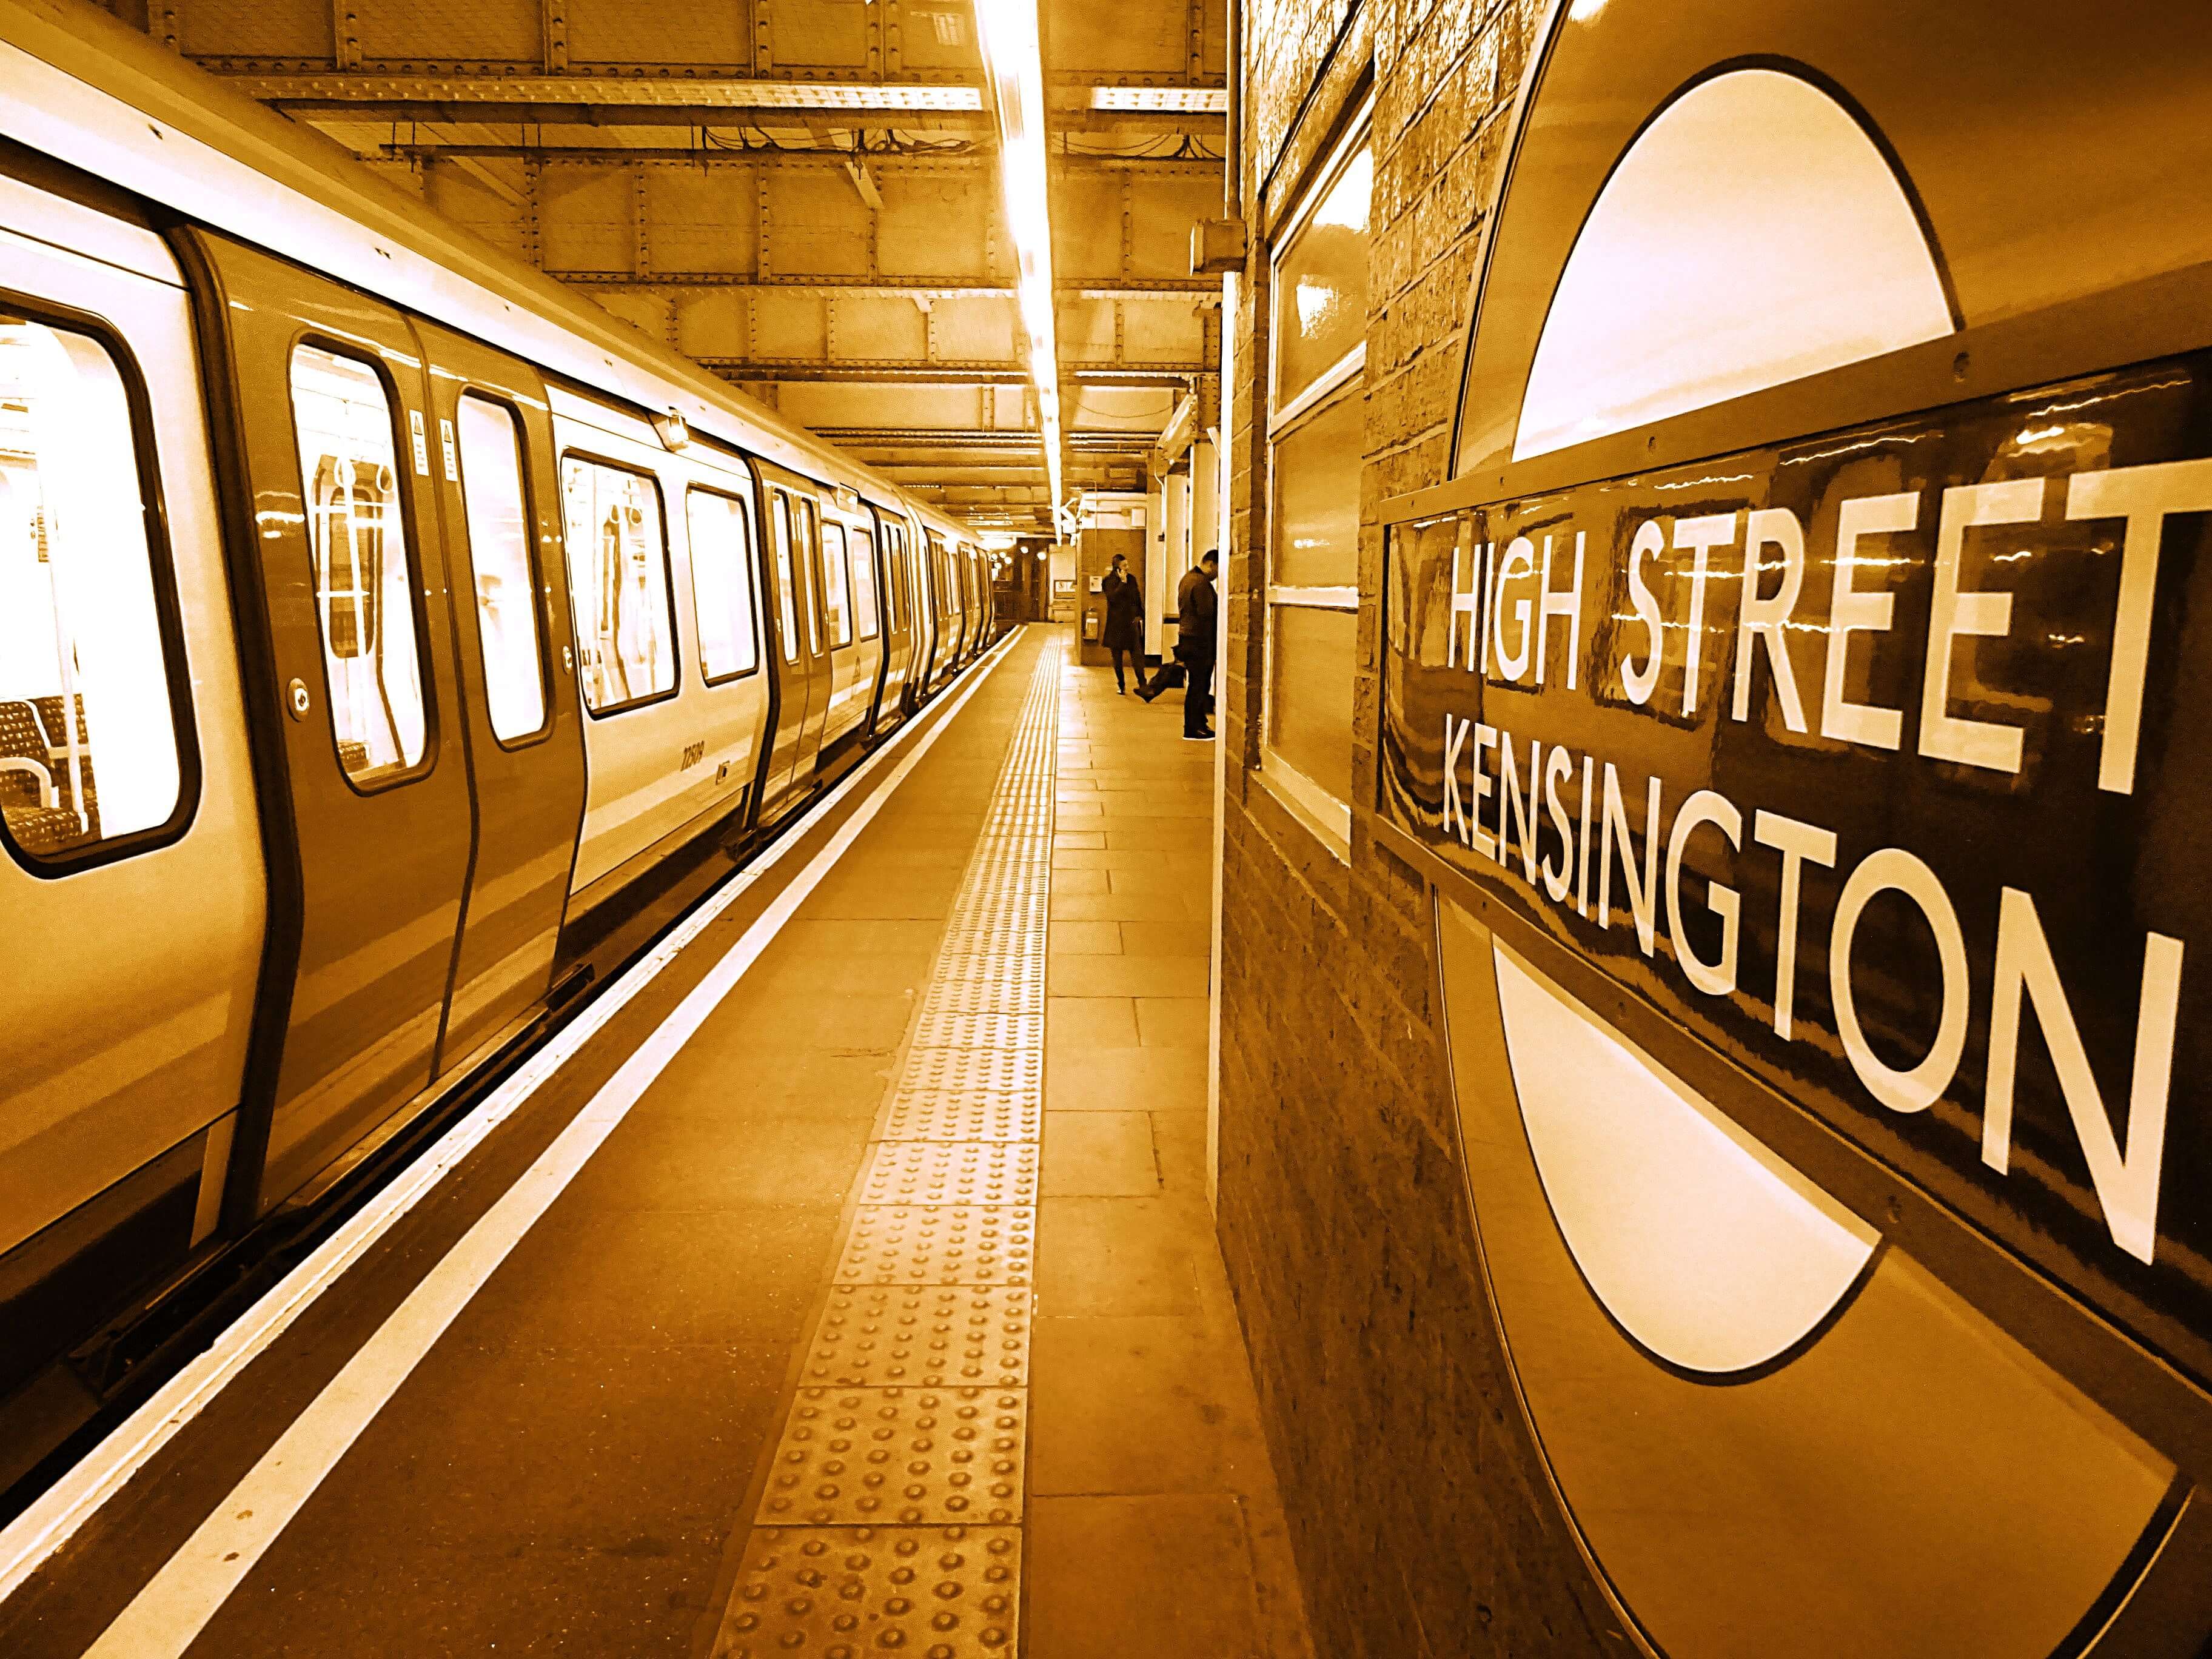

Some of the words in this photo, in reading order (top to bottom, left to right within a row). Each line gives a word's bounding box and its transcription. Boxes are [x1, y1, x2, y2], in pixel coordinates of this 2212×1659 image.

[1447, 531, 1586, 691] HIGH
[1620, 458, 2212, 796] STREET
[1444, 713, 2185, 1265] KENSINGTON
